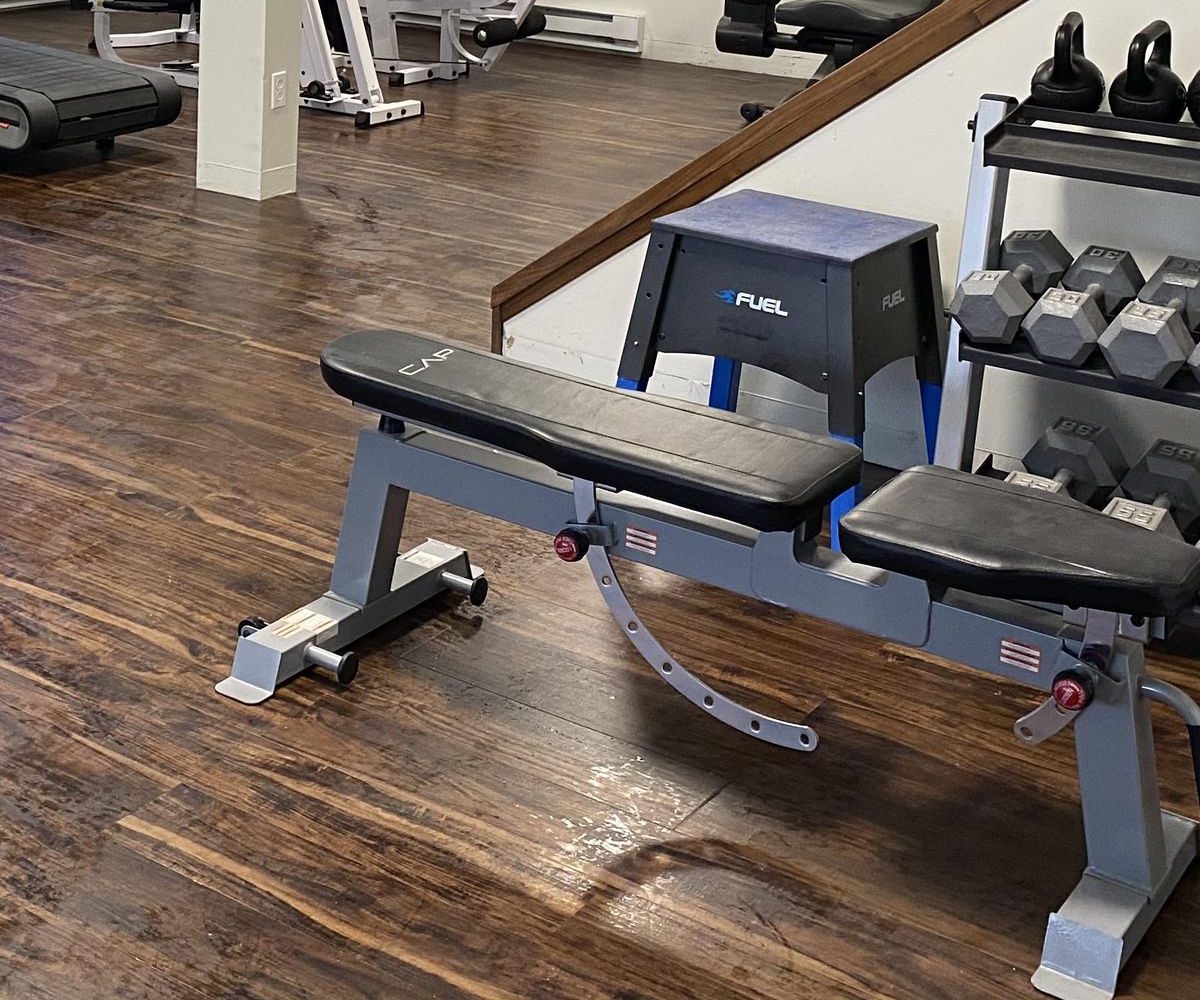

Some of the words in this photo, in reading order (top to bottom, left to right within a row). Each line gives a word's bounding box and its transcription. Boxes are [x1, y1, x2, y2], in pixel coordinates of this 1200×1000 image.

[735, 291, 789, 317] FUEL
[882, 288, 905, 312] FUEL
[398, 348, 454, 376] CAP
